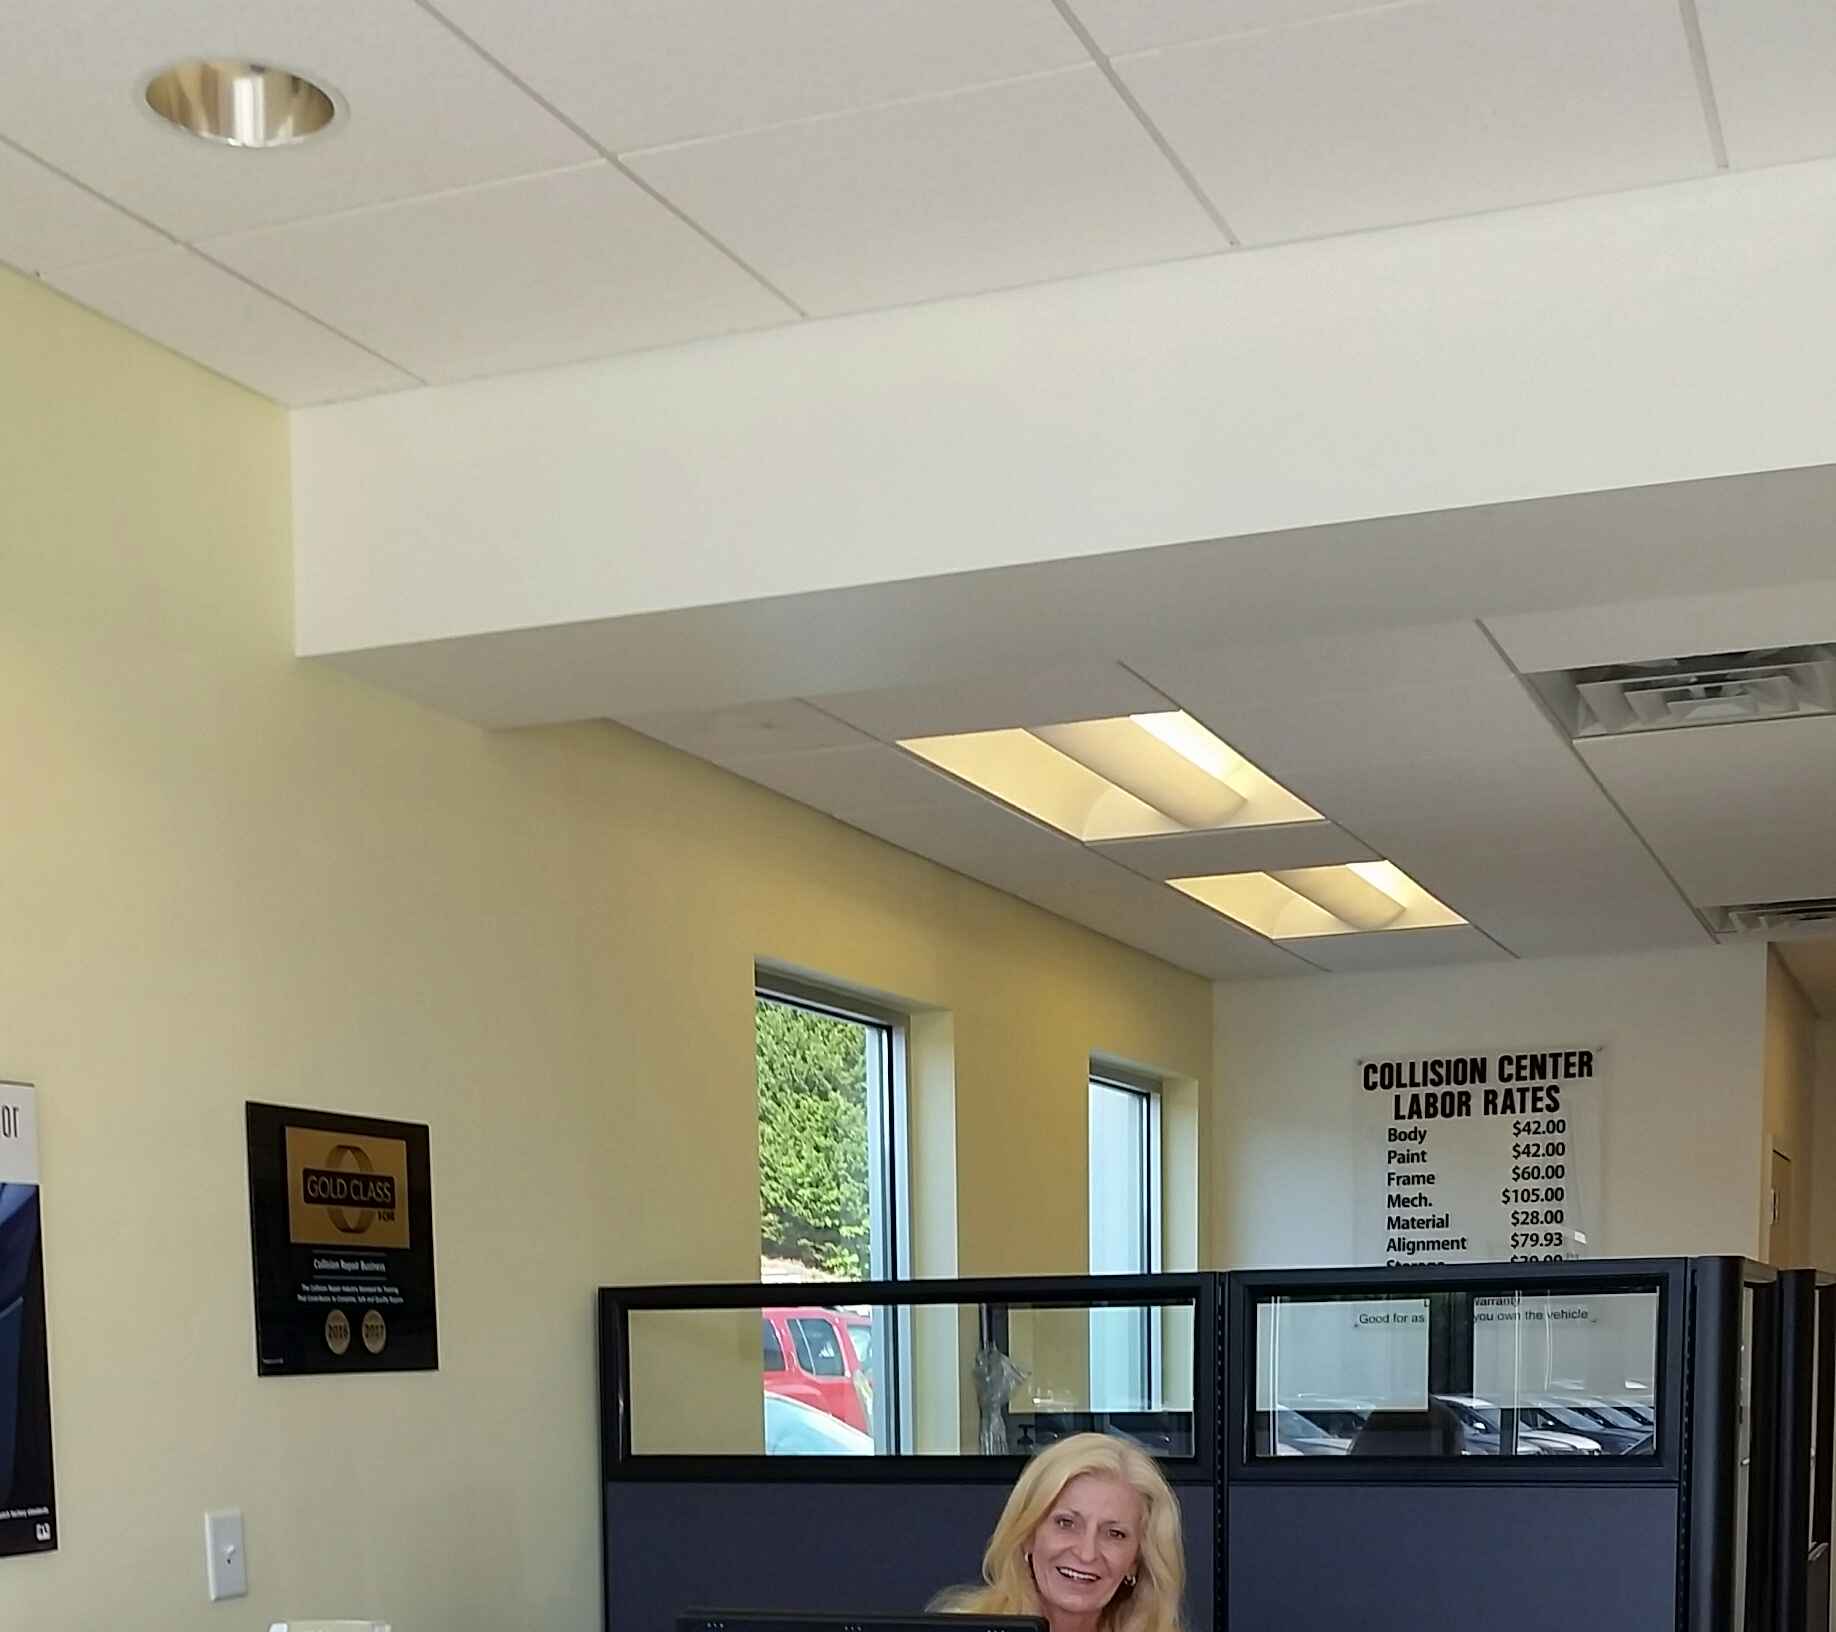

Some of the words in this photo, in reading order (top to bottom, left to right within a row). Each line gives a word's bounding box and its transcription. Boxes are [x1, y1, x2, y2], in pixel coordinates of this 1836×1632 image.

[1363, 1057, 1487, 1090] COLLISION
[1498, 1050, 1593, 1083] CENTER
[1394, 1090, 1471, 1120] LABOR
[1483, 1084, 1560, 1116] RATES
[1387, 1126, 1427, 1144] Body
[1512, 1119, 1566, 1137] $42.00
[1387, 1149, 1427, 1164] Paint
[1512, 1142, 1566, 1159] $42.00
[1387, 1172, 1436, 1186] Frame
[1511, 1164, 1565, 1182] $60.00
[307, 1175, 348, 1199] GOLD
[350, 1179, 391, 1203] CLASS
[1387, 1192, 1433, 1208] Mech.
[1501, 1187, 1565, 1205] $105.00
[1387, 1213, 1450, 1230] Material
[1511, 1209, 1564, 1227] $28.00
[1386, 1236, 1467, 1255] Alignment
[1510, 1232, 1563, 1250] $79.93
[1359, 1313, 1389, 1324] Good
[1393, 1313, 1409, 1323] for
[1412, 1315, 1425, 1323] as
[1525, 1309, 1543, 1320] the
